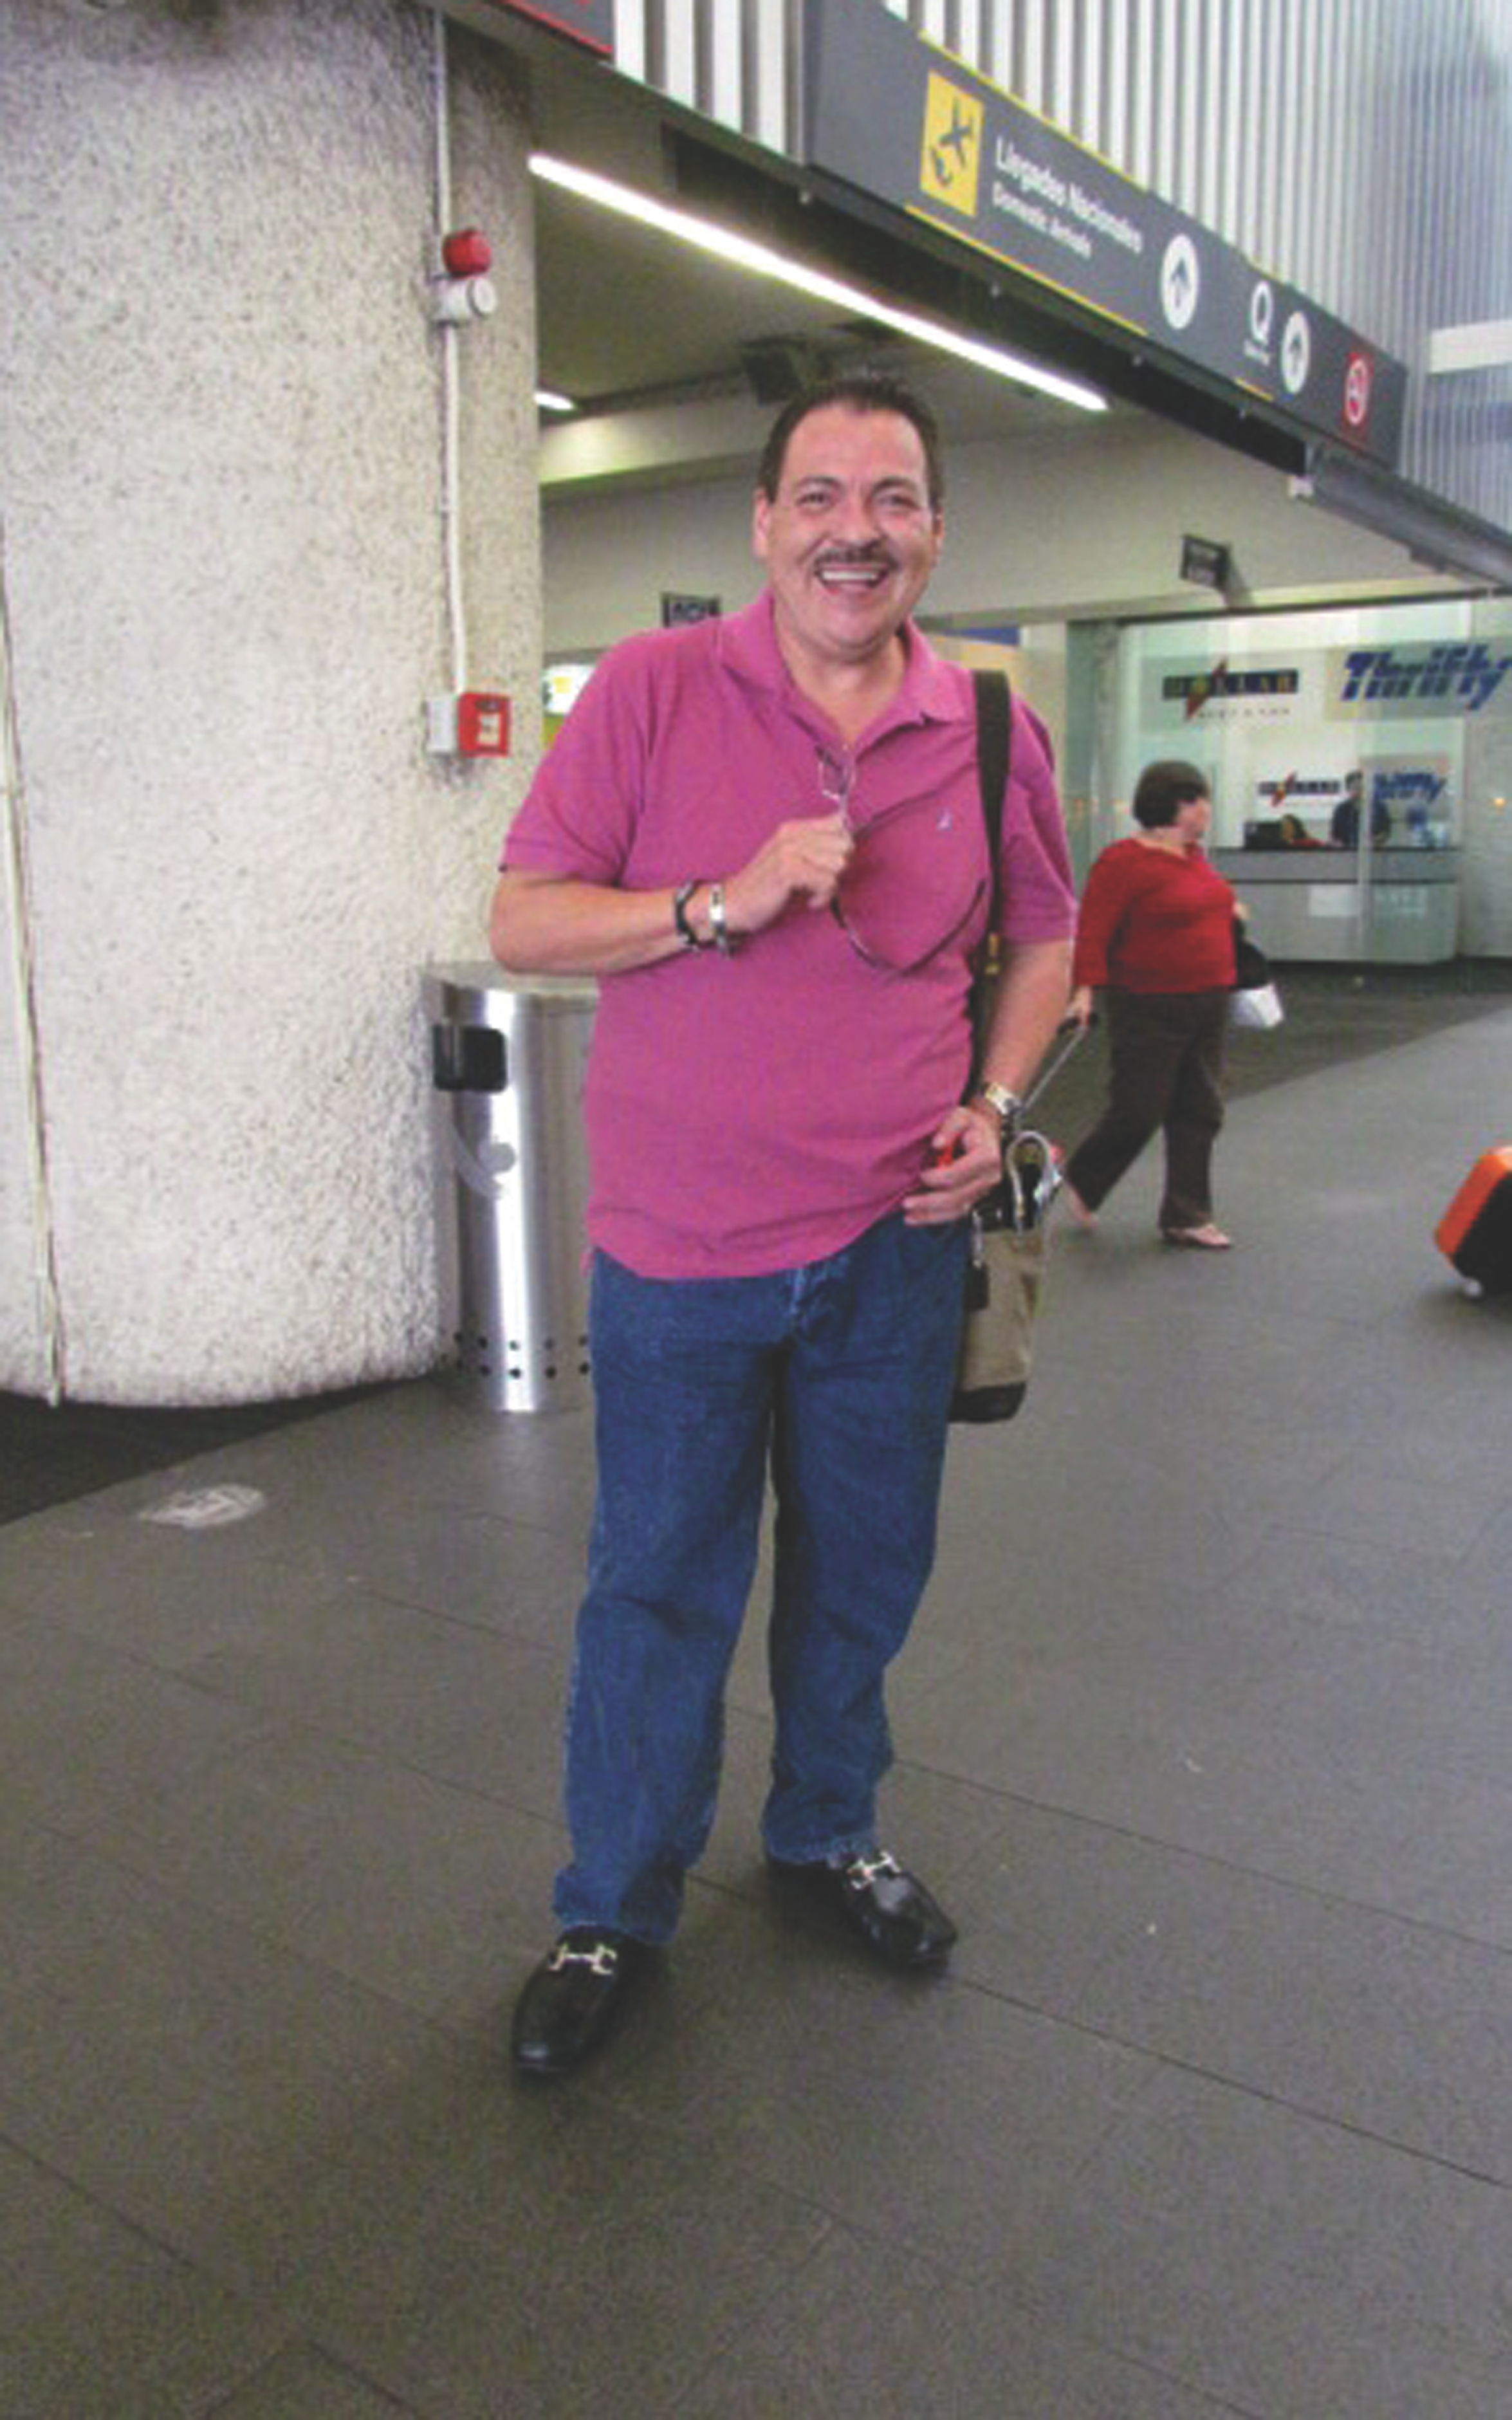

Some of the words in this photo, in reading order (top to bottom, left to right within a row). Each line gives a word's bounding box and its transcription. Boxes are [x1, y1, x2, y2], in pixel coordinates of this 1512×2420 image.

[995, 134, 1065, 207] Llegadas
[1069, 181, 1143, 255] Nacionales
[1341, 642, 1512, 710] Thrifty
